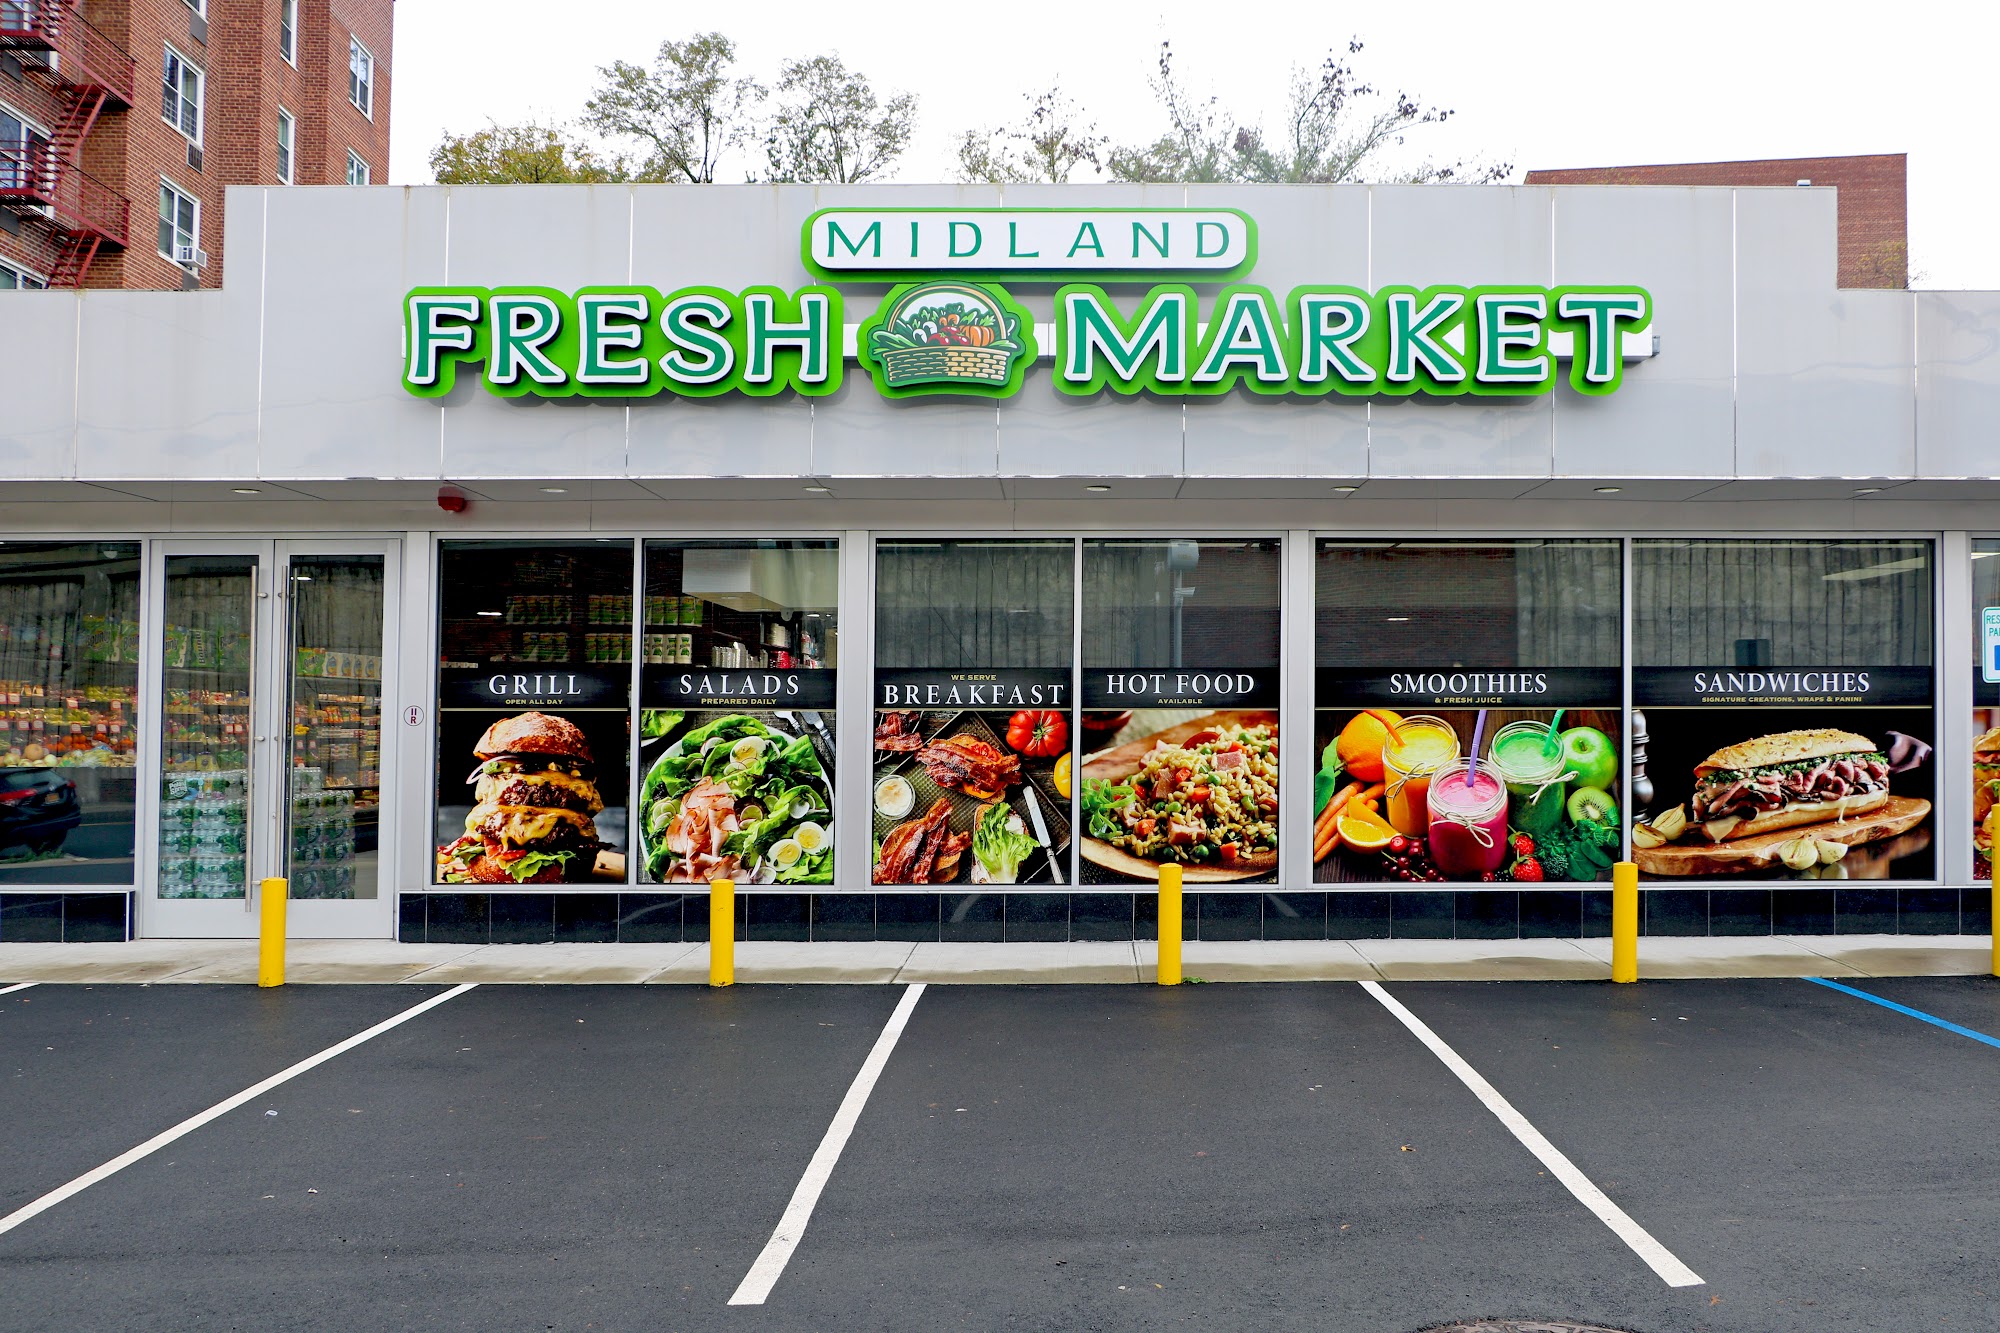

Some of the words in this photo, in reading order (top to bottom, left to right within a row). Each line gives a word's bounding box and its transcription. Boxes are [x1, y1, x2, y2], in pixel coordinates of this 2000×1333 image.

[826, 221, 1231, 259] MIDLAND
[407, 293, 830, 385] FRESH
[1064, 292, 1646, 383] MARKET
[1989, 628, 2000, 636] PA
[488, 674, 582, 695] GRILL
[679, 674, 800, 695] SALADS
[1106, 673, 1167, 694] HOT
[1175, 673, 1255, 694] FOOD
[1389, 673, 1548, 694] SMOOTHIES
[1693, 672, 1870, 693] SANDWICHES
[883, 684, 1065, 705] BREAKFAST
[1748, 696, 1795, 704] CREATIONS,
[410, 716, 417, 724] R
